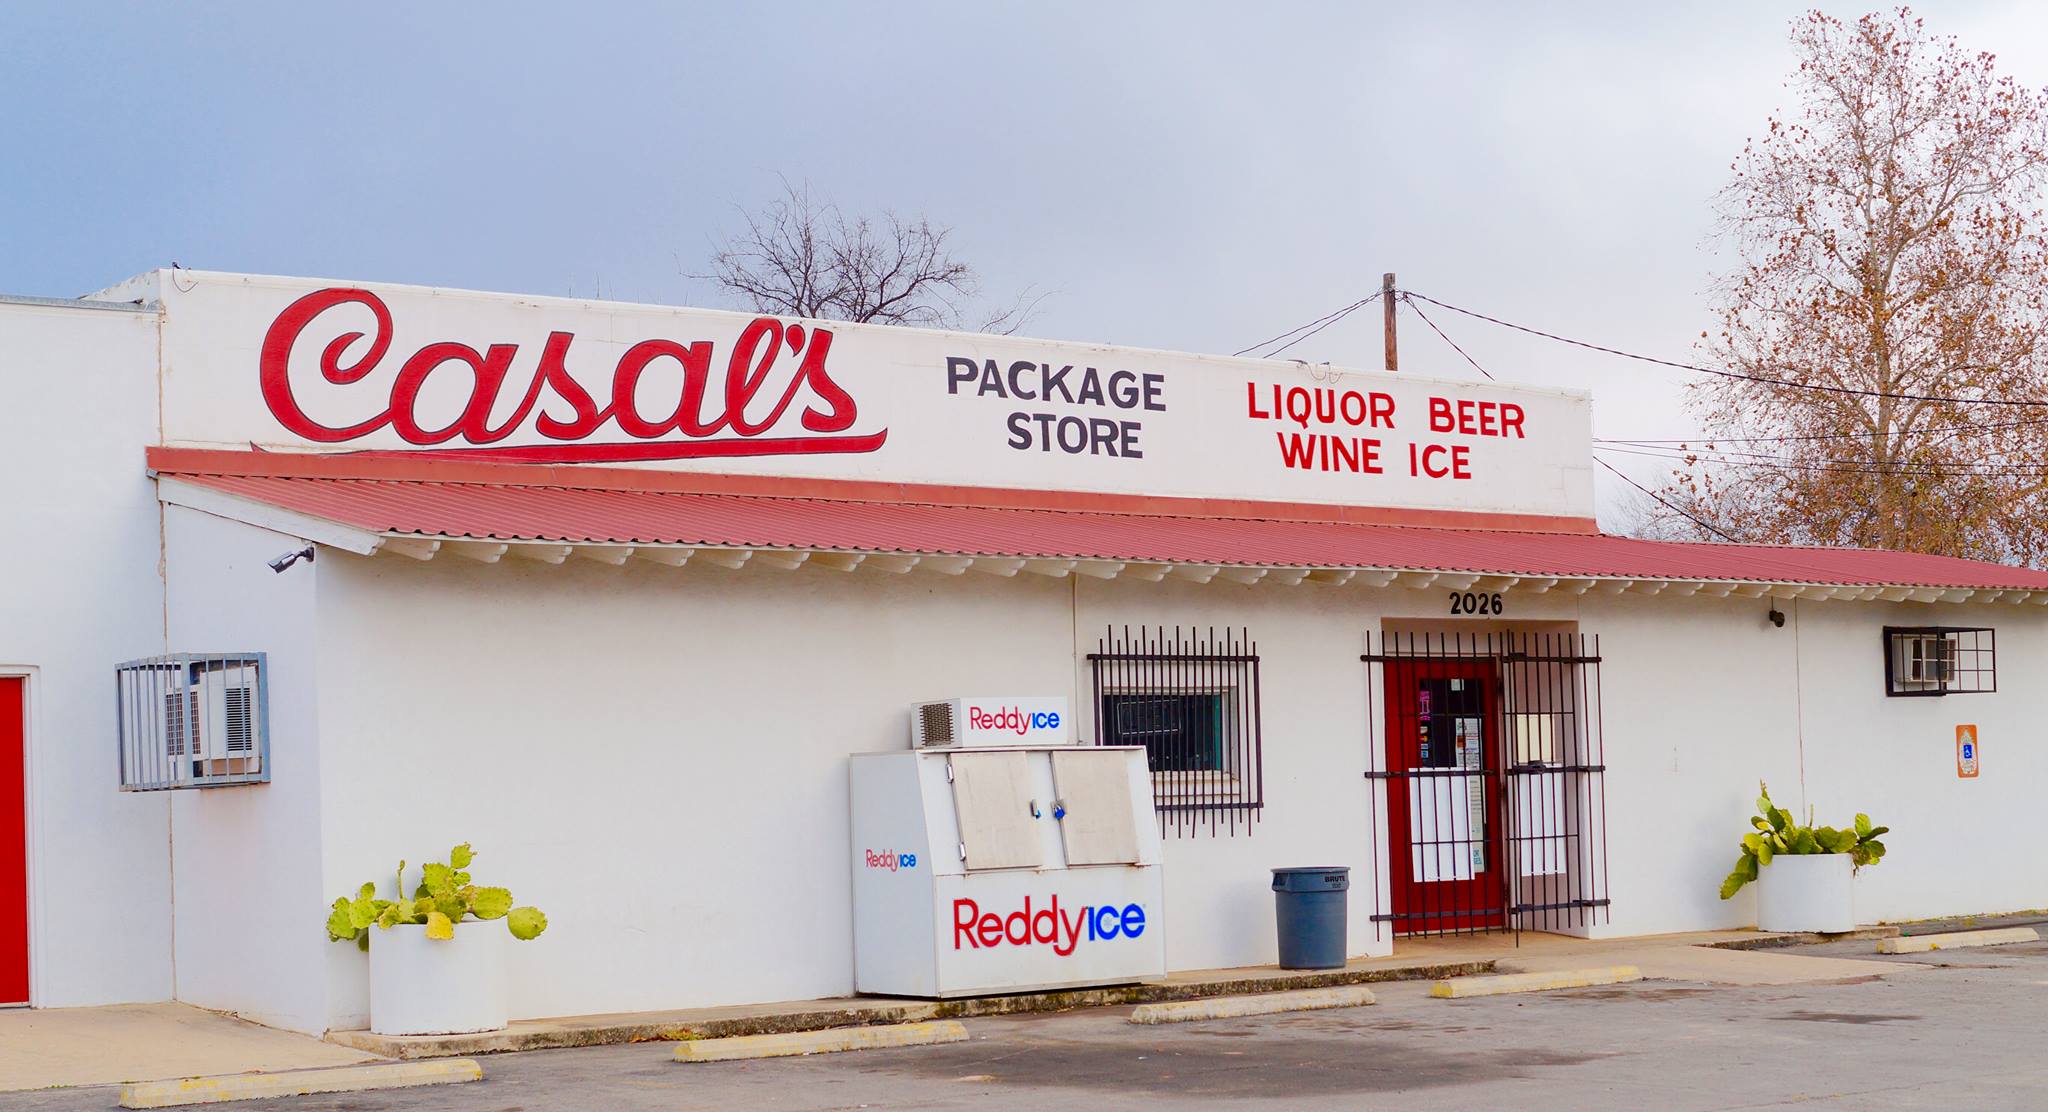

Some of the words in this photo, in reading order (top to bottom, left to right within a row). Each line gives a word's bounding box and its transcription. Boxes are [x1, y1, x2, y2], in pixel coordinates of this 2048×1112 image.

[260, 287, 857, 444] Casal's
[947, 356, 1166, 412] PACKAGE
[1007, 412, 1143, 459] STORE
[1247, 380, 1397, 430] LIQUOR
[1427, 396, 1526, 440] BEER
[1276, 431, 1384, 475] WINE
[1408, 441, 1473, 480] ICE
[1449, 592, 1503, 615] 2026
